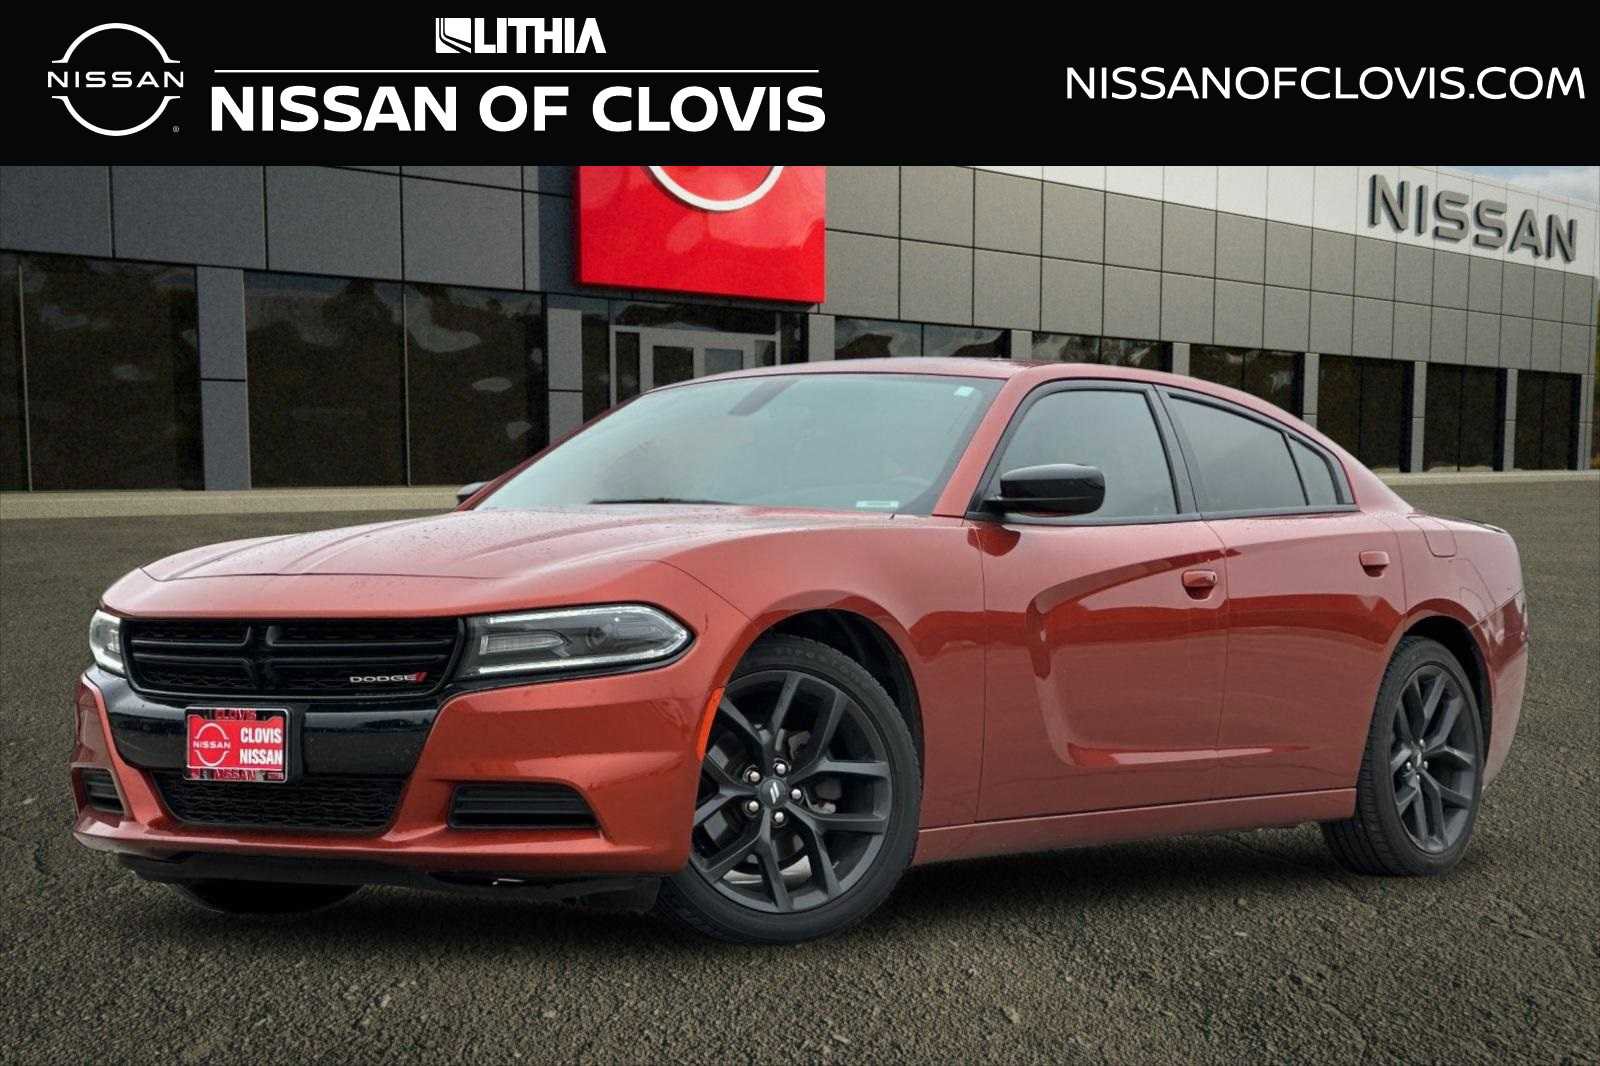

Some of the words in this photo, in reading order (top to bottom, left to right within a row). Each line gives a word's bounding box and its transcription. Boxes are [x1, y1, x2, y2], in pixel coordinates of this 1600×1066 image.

[1369, 174, 1578, 263] NISSAN
[349, 674, 417, 683] DODGE
[240, 727, 282, 744] CLOVIS
[192, 741, 231, 749] NISSAN
[239, 748, 283, 765] NISSAN
